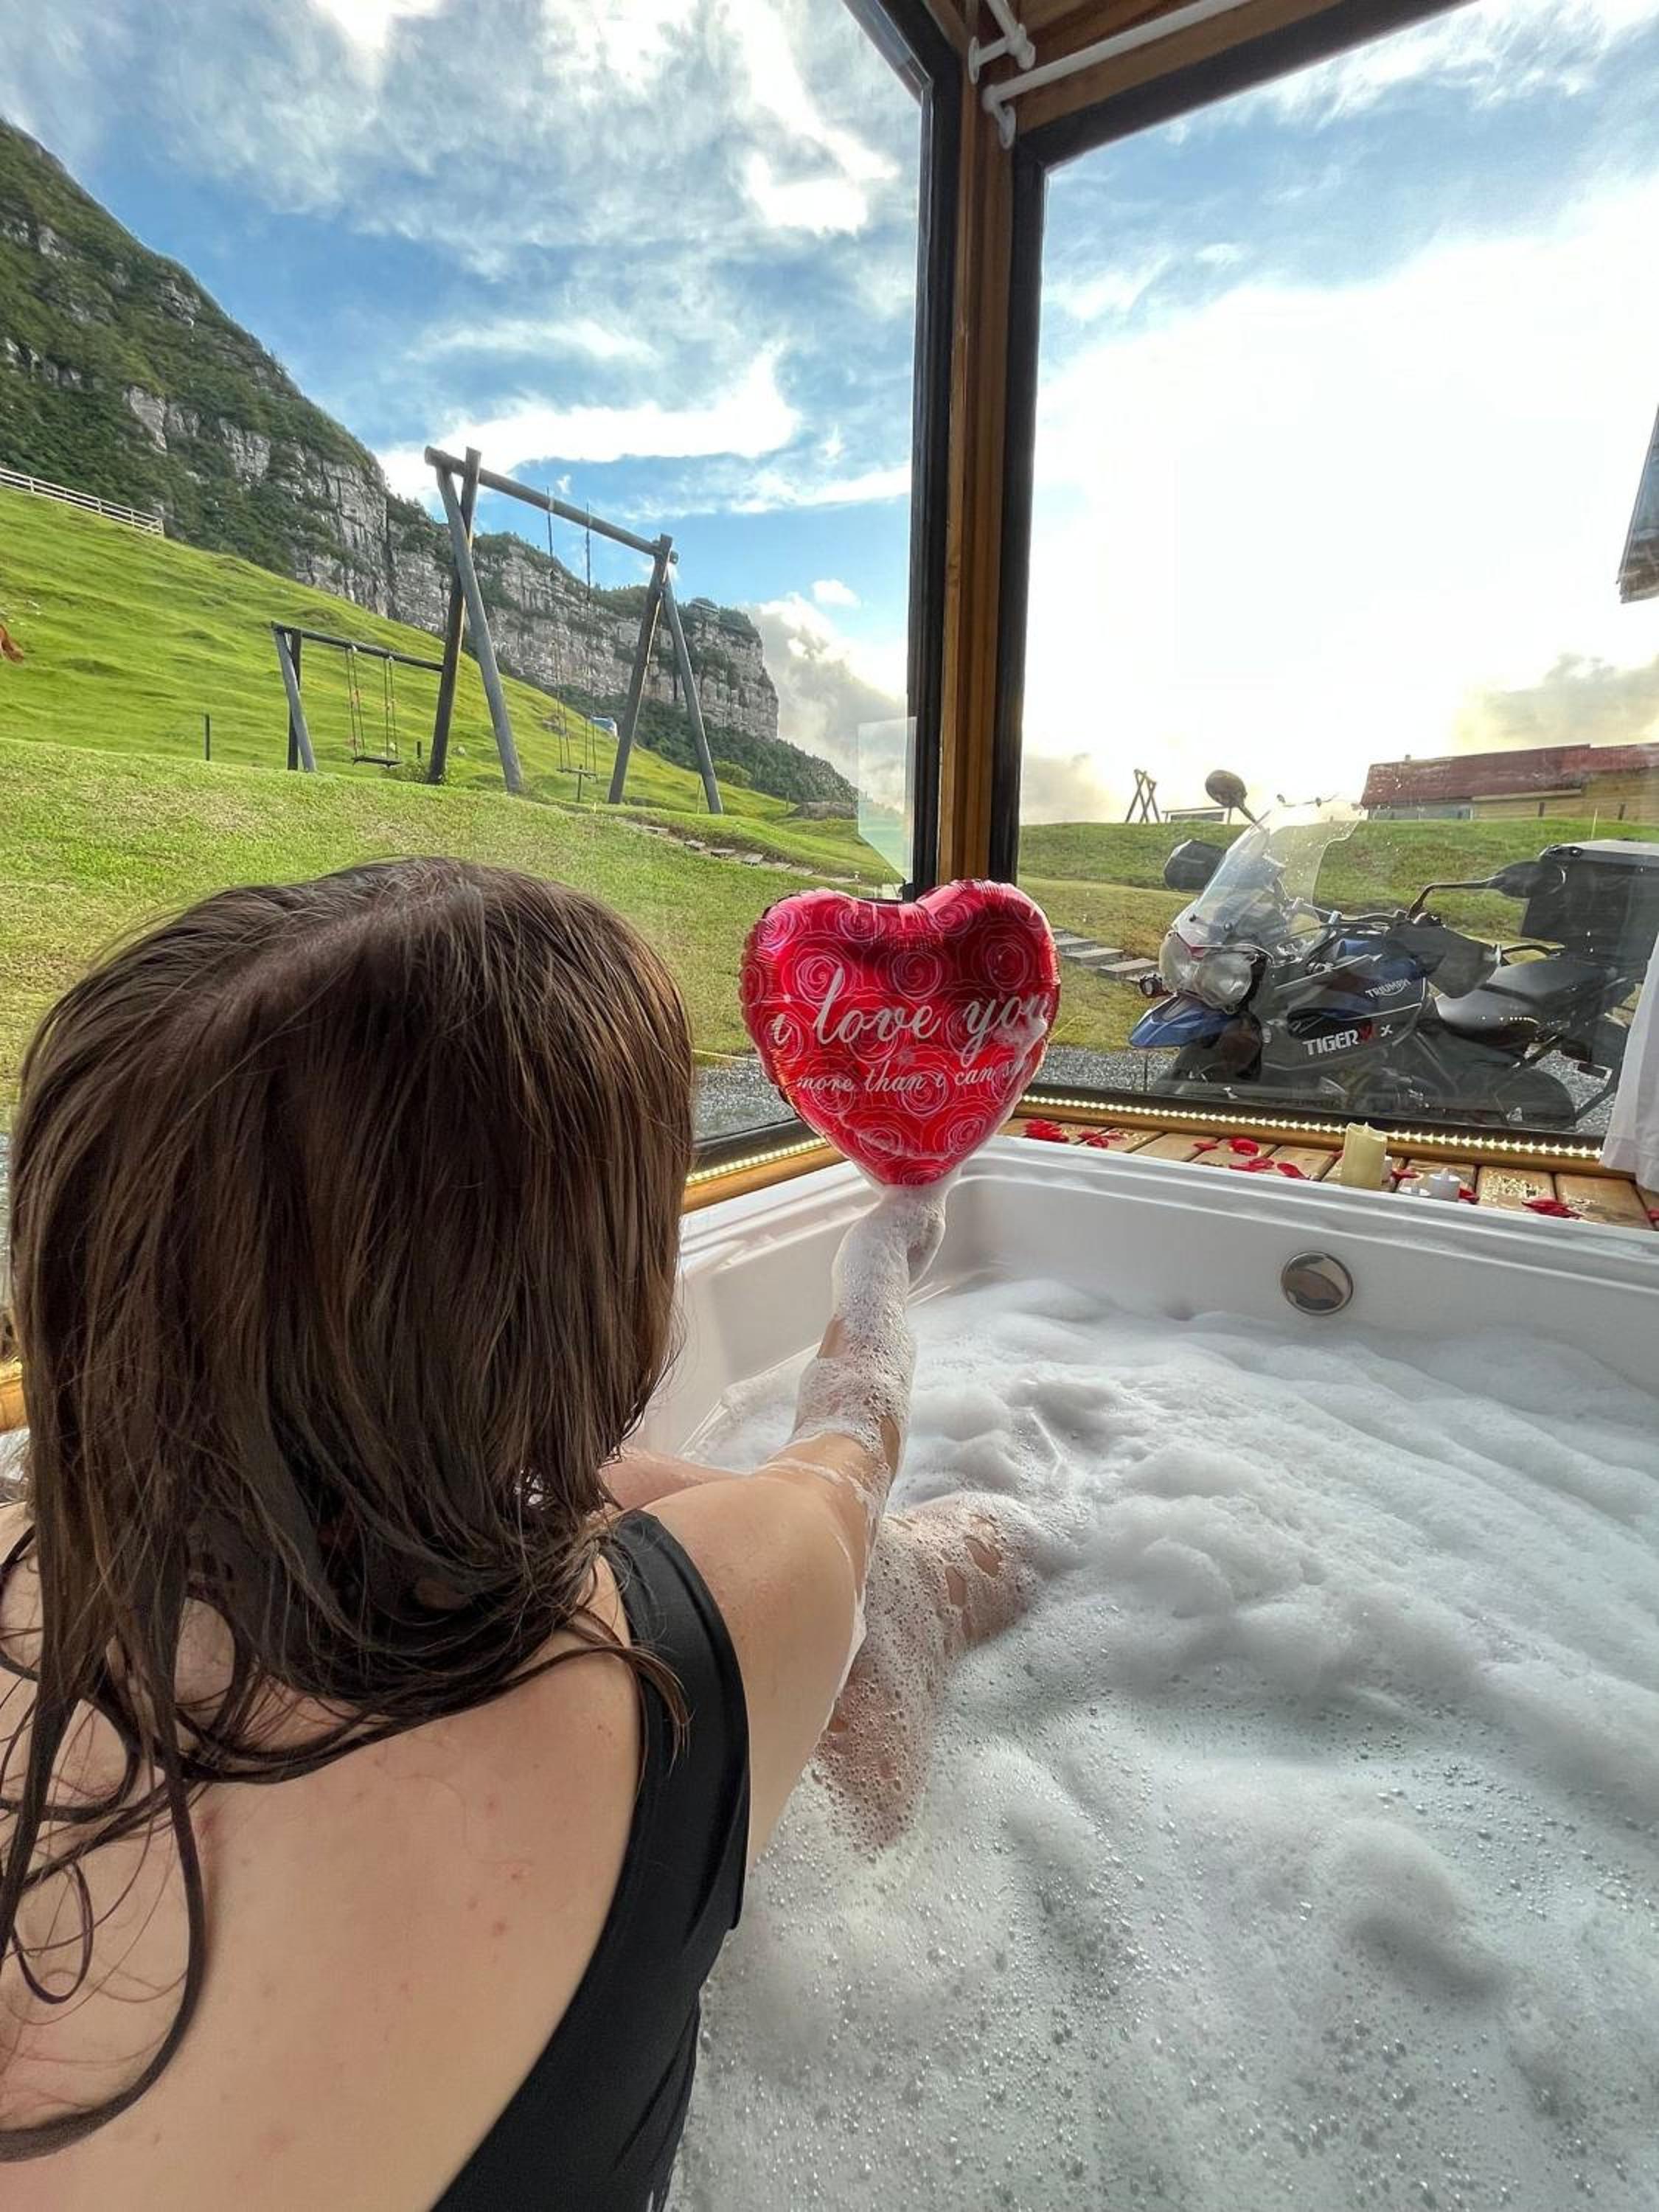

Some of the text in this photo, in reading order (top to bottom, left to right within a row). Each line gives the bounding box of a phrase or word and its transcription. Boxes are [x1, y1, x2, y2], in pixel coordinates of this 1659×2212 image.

[1365, 978, 1412, 998] TRIUMPH
[812, 966, 942, 1045] love
[1302, 1029, 1360, 1056] TIGER
[796, 1076, 855, 1092] more
[863, 1060, 928, 1093] than
[954, 1066, 995, 1086] can
